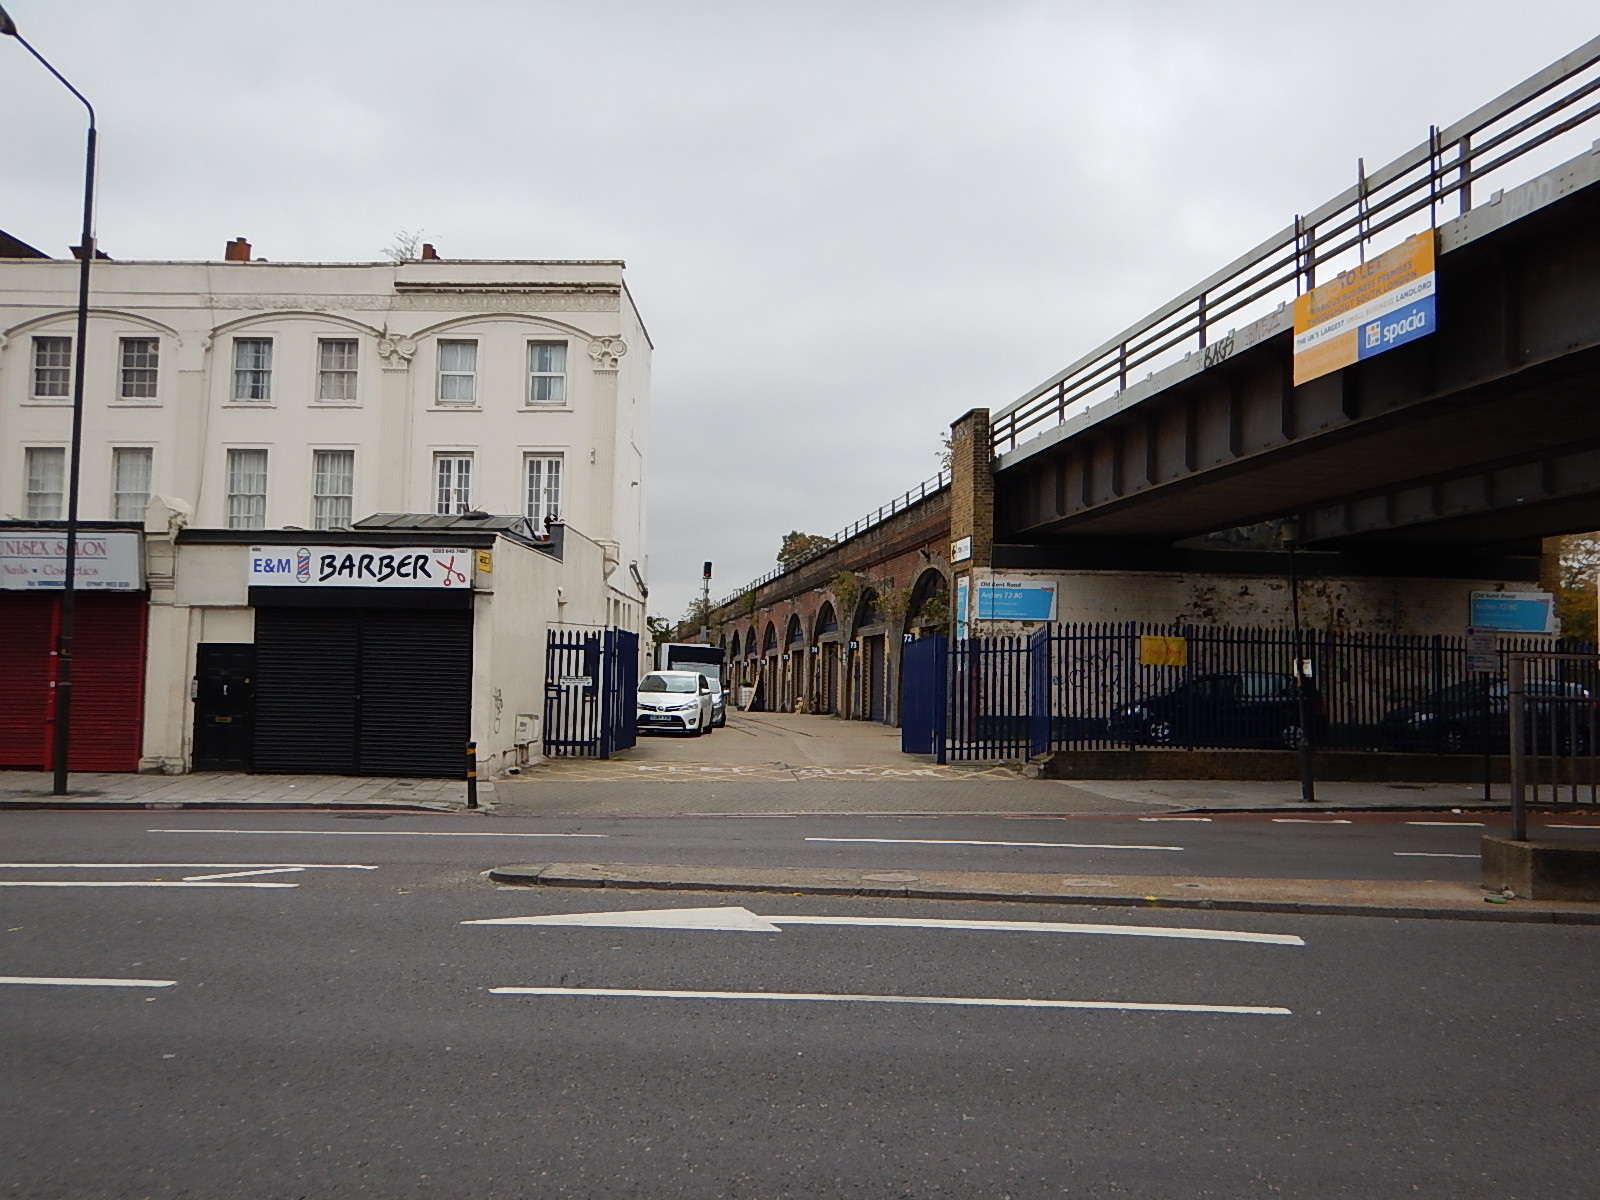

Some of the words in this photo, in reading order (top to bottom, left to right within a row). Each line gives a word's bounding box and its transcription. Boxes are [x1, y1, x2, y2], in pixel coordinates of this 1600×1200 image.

[1343, 281, 1376, 303] BUSINESS
[1378, 261, 1412, 284] PREMISES
[1296, 334, 1308, 347] THE
[1320, 320, 1345, 336] LARGEST
[1365, 299, 1394, 317] BUSINESS
[1395, 280, 1432, 302] LANDLORD
[1307, 302, 1355, 327] THROUGHOUT
[1357, 288, 1381, 307] SOUTH
[1383, 270, 1417, 292] LONDON
[1383, 308, 1425, 343] spacia
[55, 541, 107, 556] SLON
[253, 558, 291, 573] E&M
[318, 554, 432, 582] BARBER
[850, 641, 857, 649] 73
[903, 633, 913, 642] 72
